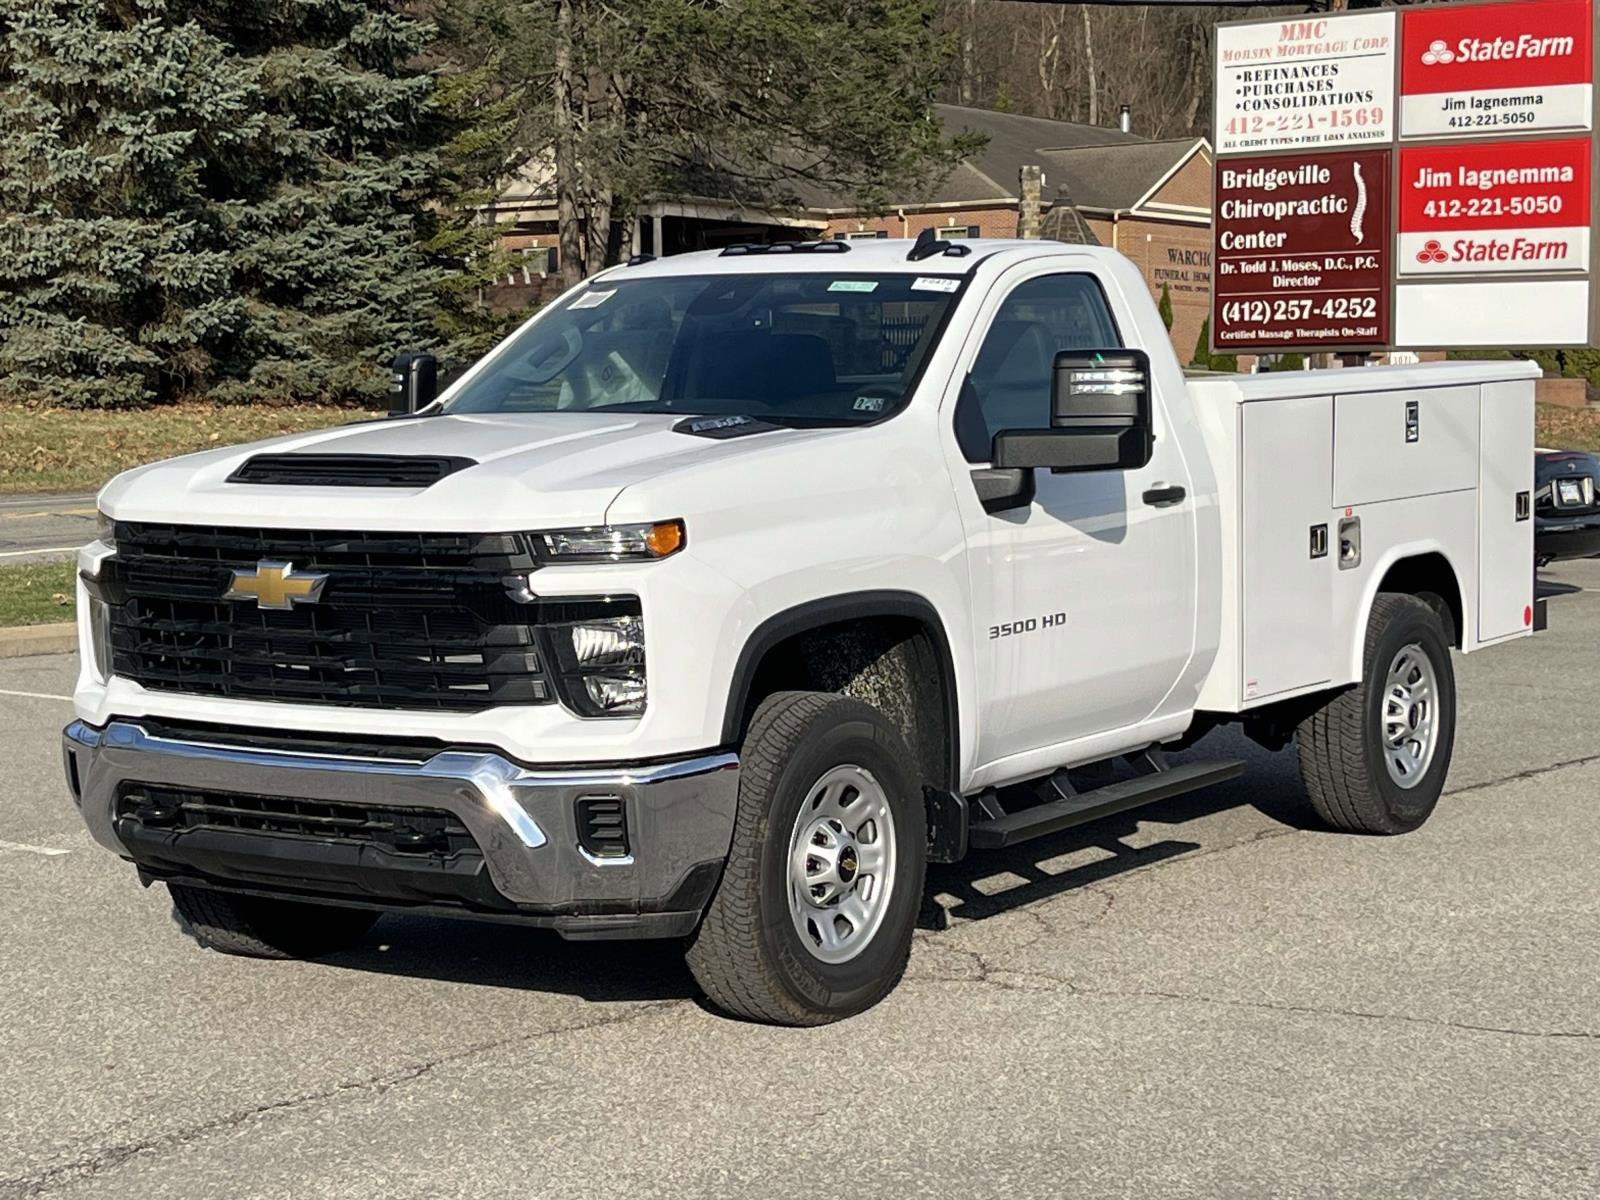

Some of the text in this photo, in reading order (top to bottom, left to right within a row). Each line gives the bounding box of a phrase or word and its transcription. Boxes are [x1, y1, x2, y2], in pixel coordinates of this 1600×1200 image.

[1279, 21, 1328, 42] MMC
[1276, 42, 1348, 58] MORTGAGE
[1243, 63, 1339, 82] REFINANCES
[1243, 79, 1334, 97] PURCHASES
[1243, 90, 1373, 112] CONSOLIDATIONS
[1441, 97, 1466, 111] Jim
[1224, 107, 1384, 135] 412-221-1569
[1448, 112, 1535, 128] 412-221-5050
[1240, 138, 1267, 147] CREDIT
[1270, 136, 1294, 145] TYPES
[1301, 135, 1321, 143] FREE
[1324, 133, 1345, 142] LOAN
[1347, 130, 1385, 140] ANALYSIS
[1222, 164, 1330, 191] Bridgeville
[1413, 167, 1452, 189] Jim
[1220, 194, 1348, 221] Chiropractic
[1423, 195, 1562, 218] 412-221-5050
[1220, 230, 1287, 250] Center
[1154, 268, 1189, 281] FUNERAL
[1220, 256, 1379, 274] Dr. Todd J. Moses, D.C., P.C.
[1272, 275, 1322, 288] Director
[1222, 297, 1376, 325] (412) 257-4252
[1220, 326, 1378, 340] Certified Massage Therapists On-Staff
[989, 612, 1067, 640] 3500 HD
